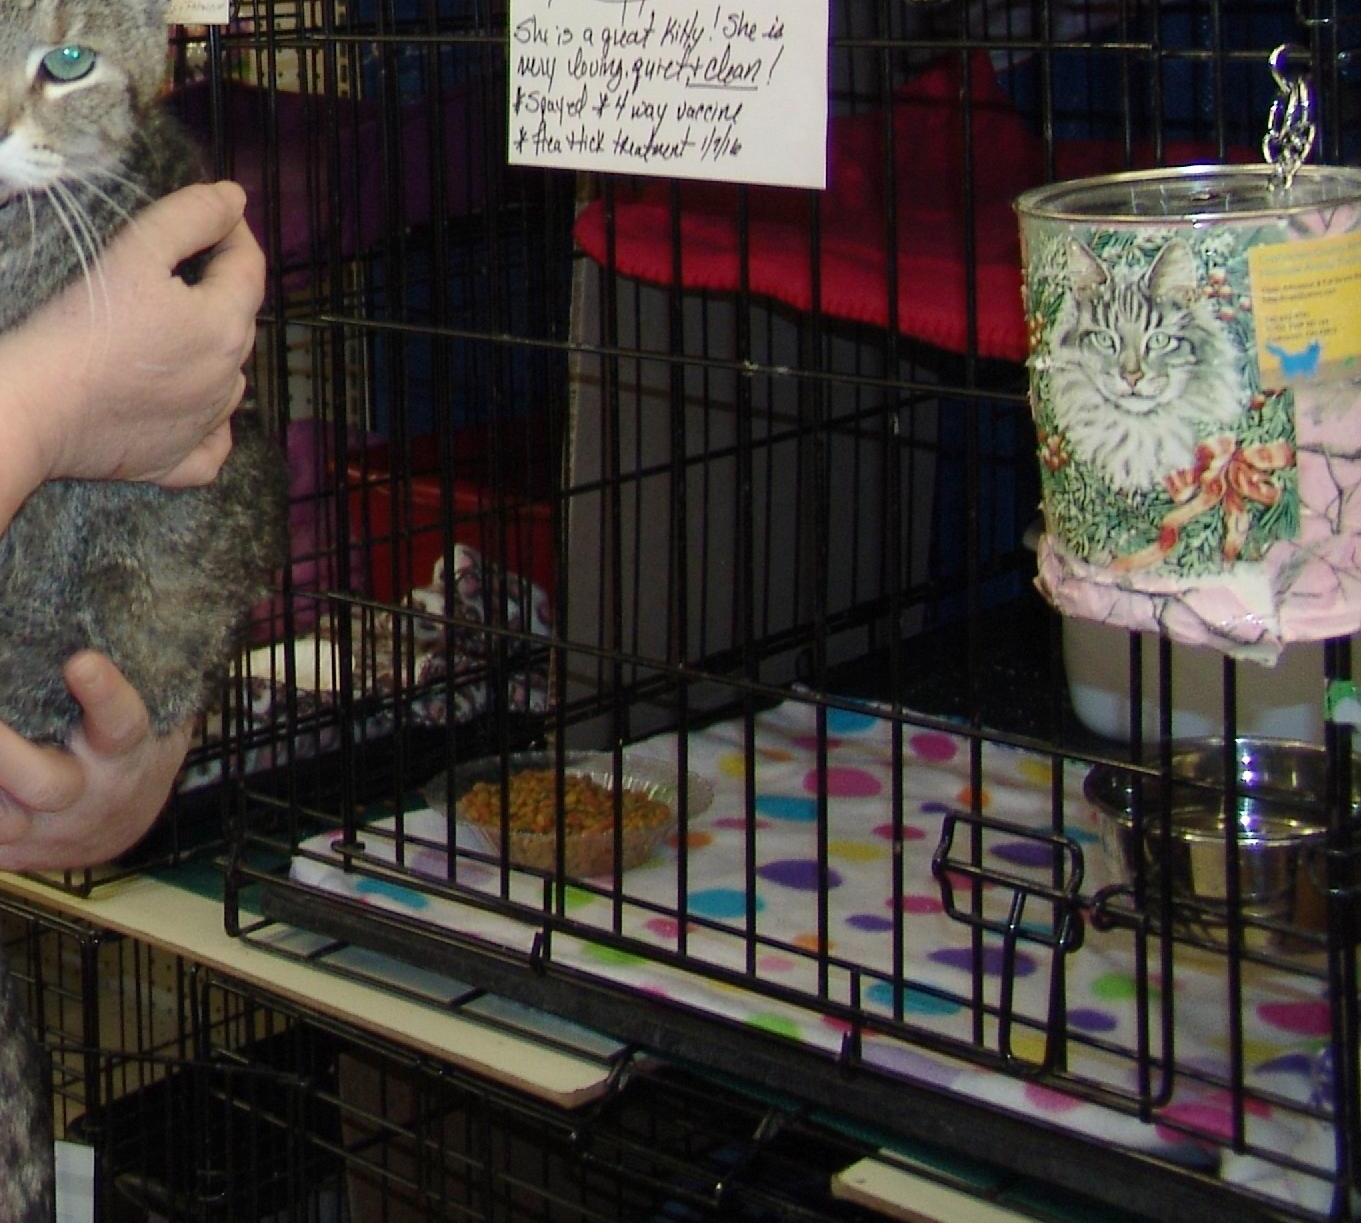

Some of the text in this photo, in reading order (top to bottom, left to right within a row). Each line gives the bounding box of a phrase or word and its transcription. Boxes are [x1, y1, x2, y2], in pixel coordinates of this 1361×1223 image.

[514, 15, 548, 45] She
[556, 25, 573, 46] is
[583, 26, 594, 46] a
[602, 10, 655, 60] great
[723, 10, 757, 41] She
[518, 55, 557, 93] very
[677, 100, 743, 124] vaccine
